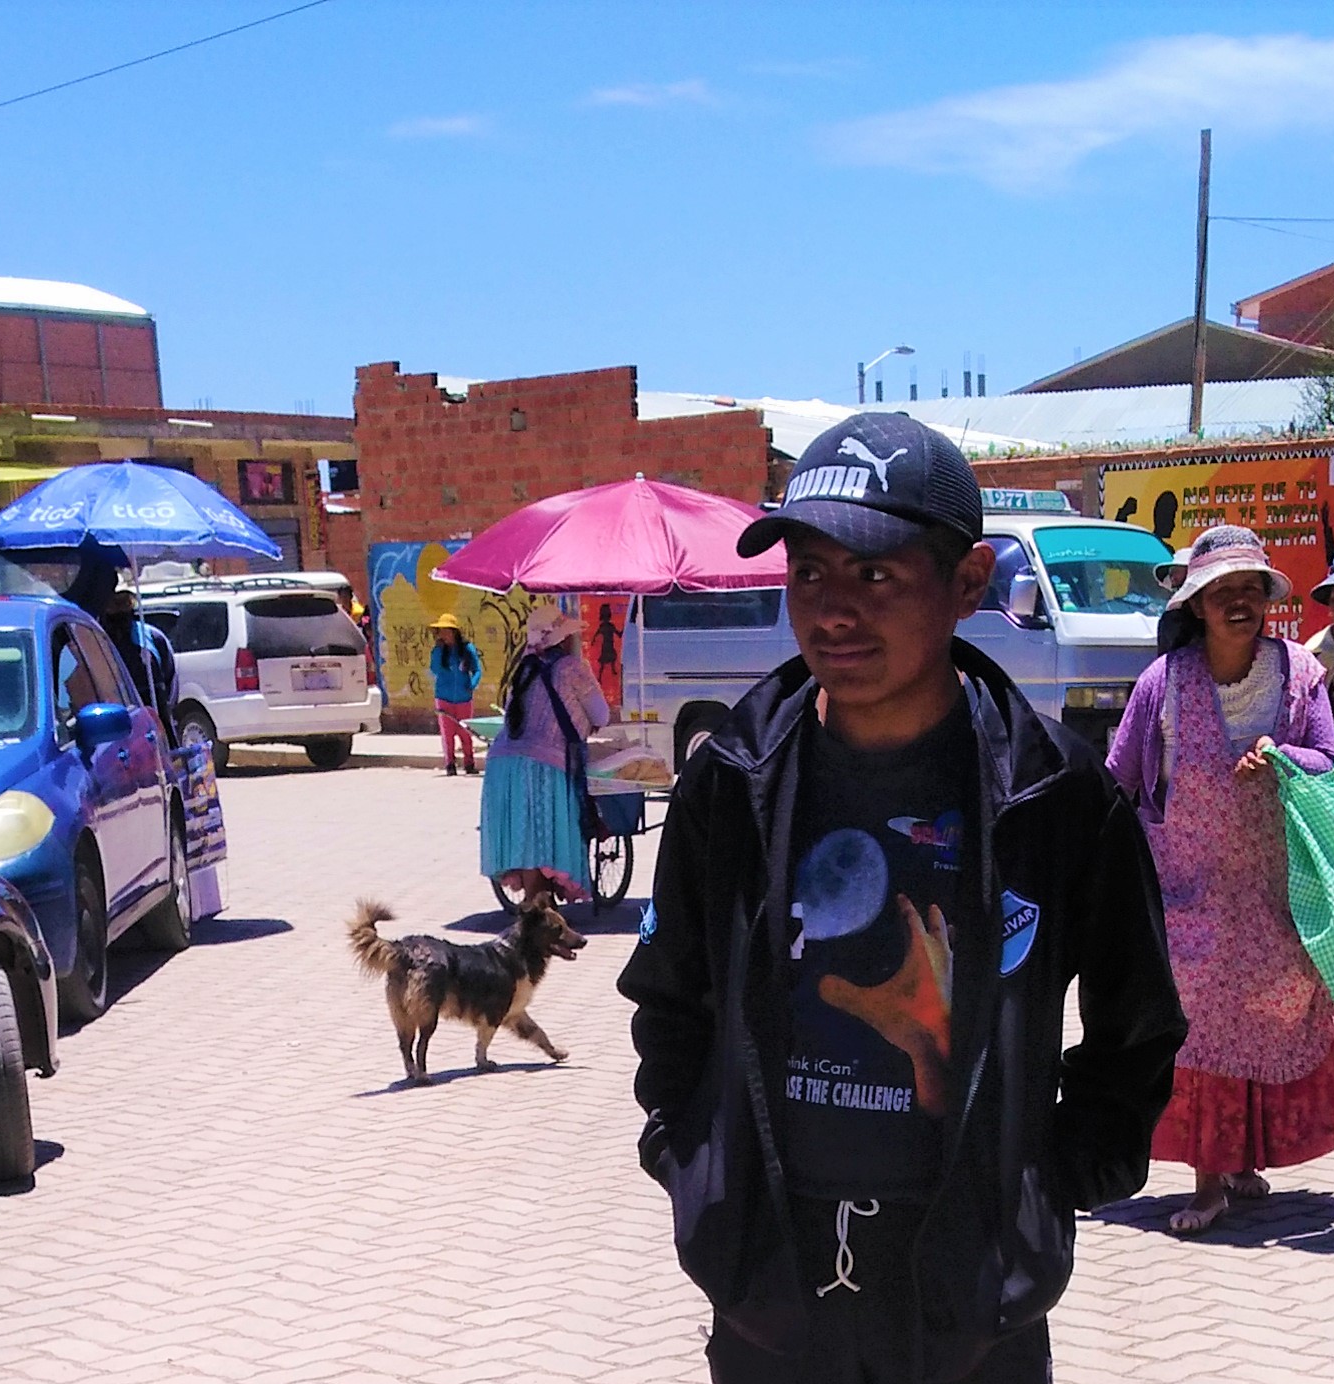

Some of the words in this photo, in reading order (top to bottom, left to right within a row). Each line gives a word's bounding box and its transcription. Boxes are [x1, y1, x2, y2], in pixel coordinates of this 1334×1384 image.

[783, 464, 871, 508] PUMA
[806, 1077, 830, 1105] THE
[832, 1081, 913, 1112] CHALLENGE
